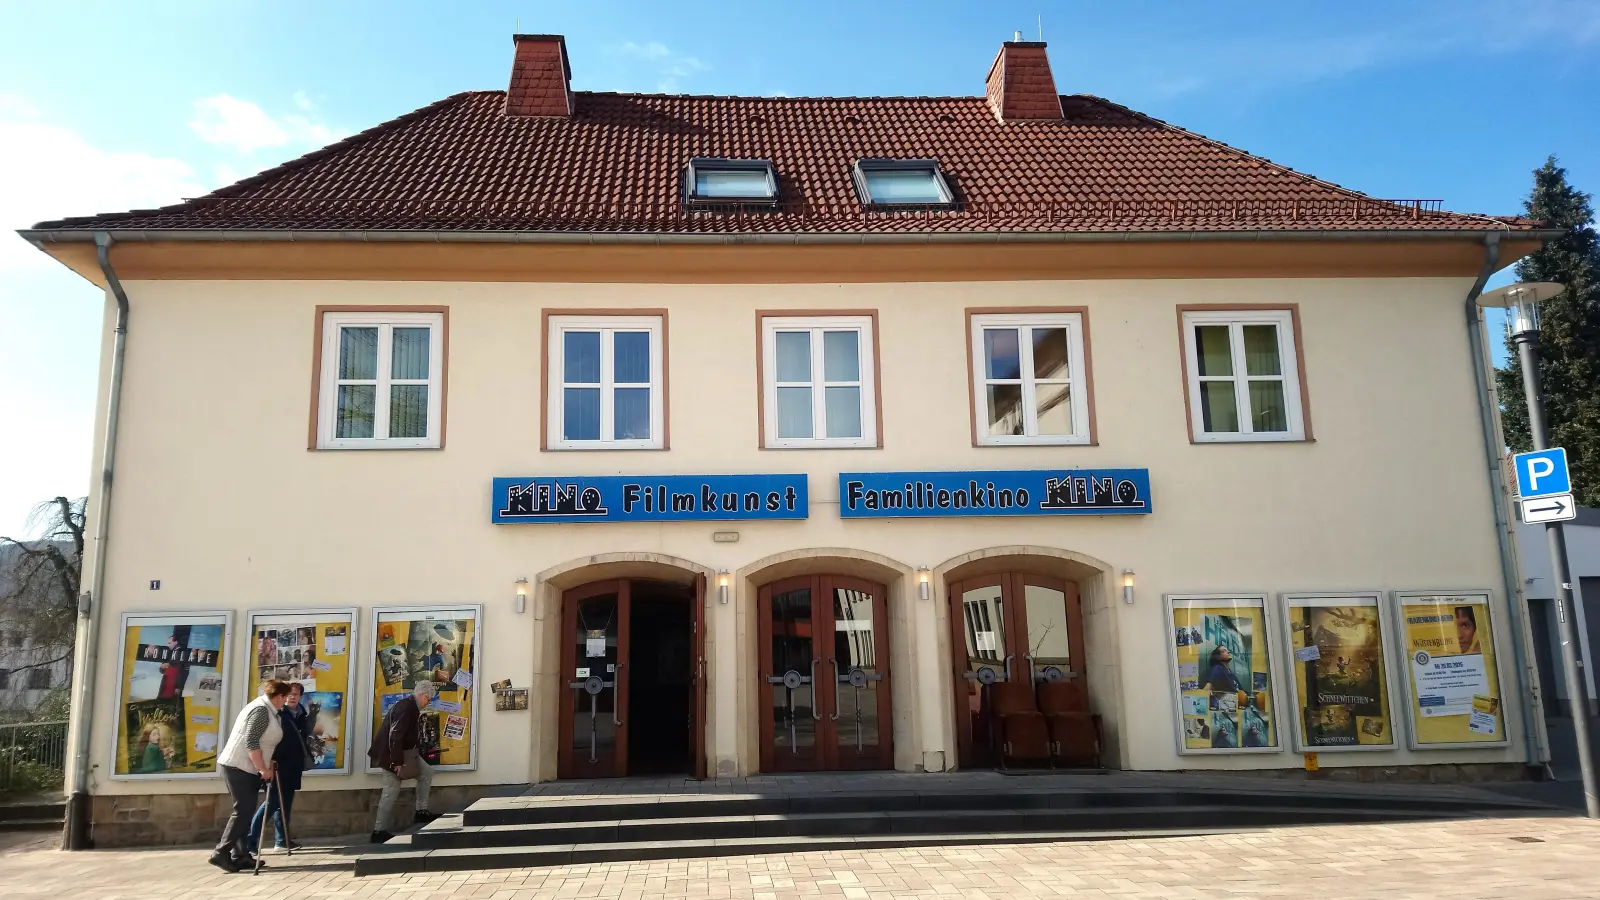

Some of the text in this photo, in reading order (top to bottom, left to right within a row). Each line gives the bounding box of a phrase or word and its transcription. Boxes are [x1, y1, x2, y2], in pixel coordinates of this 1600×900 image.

[847, 472, 1145, 510] Familienkino KINO
[1527, 457, 1555, 491] P
[500, 479, 797, 516] KINO Filmkunst
[143, 647, 213, 664] KONKLAVE
